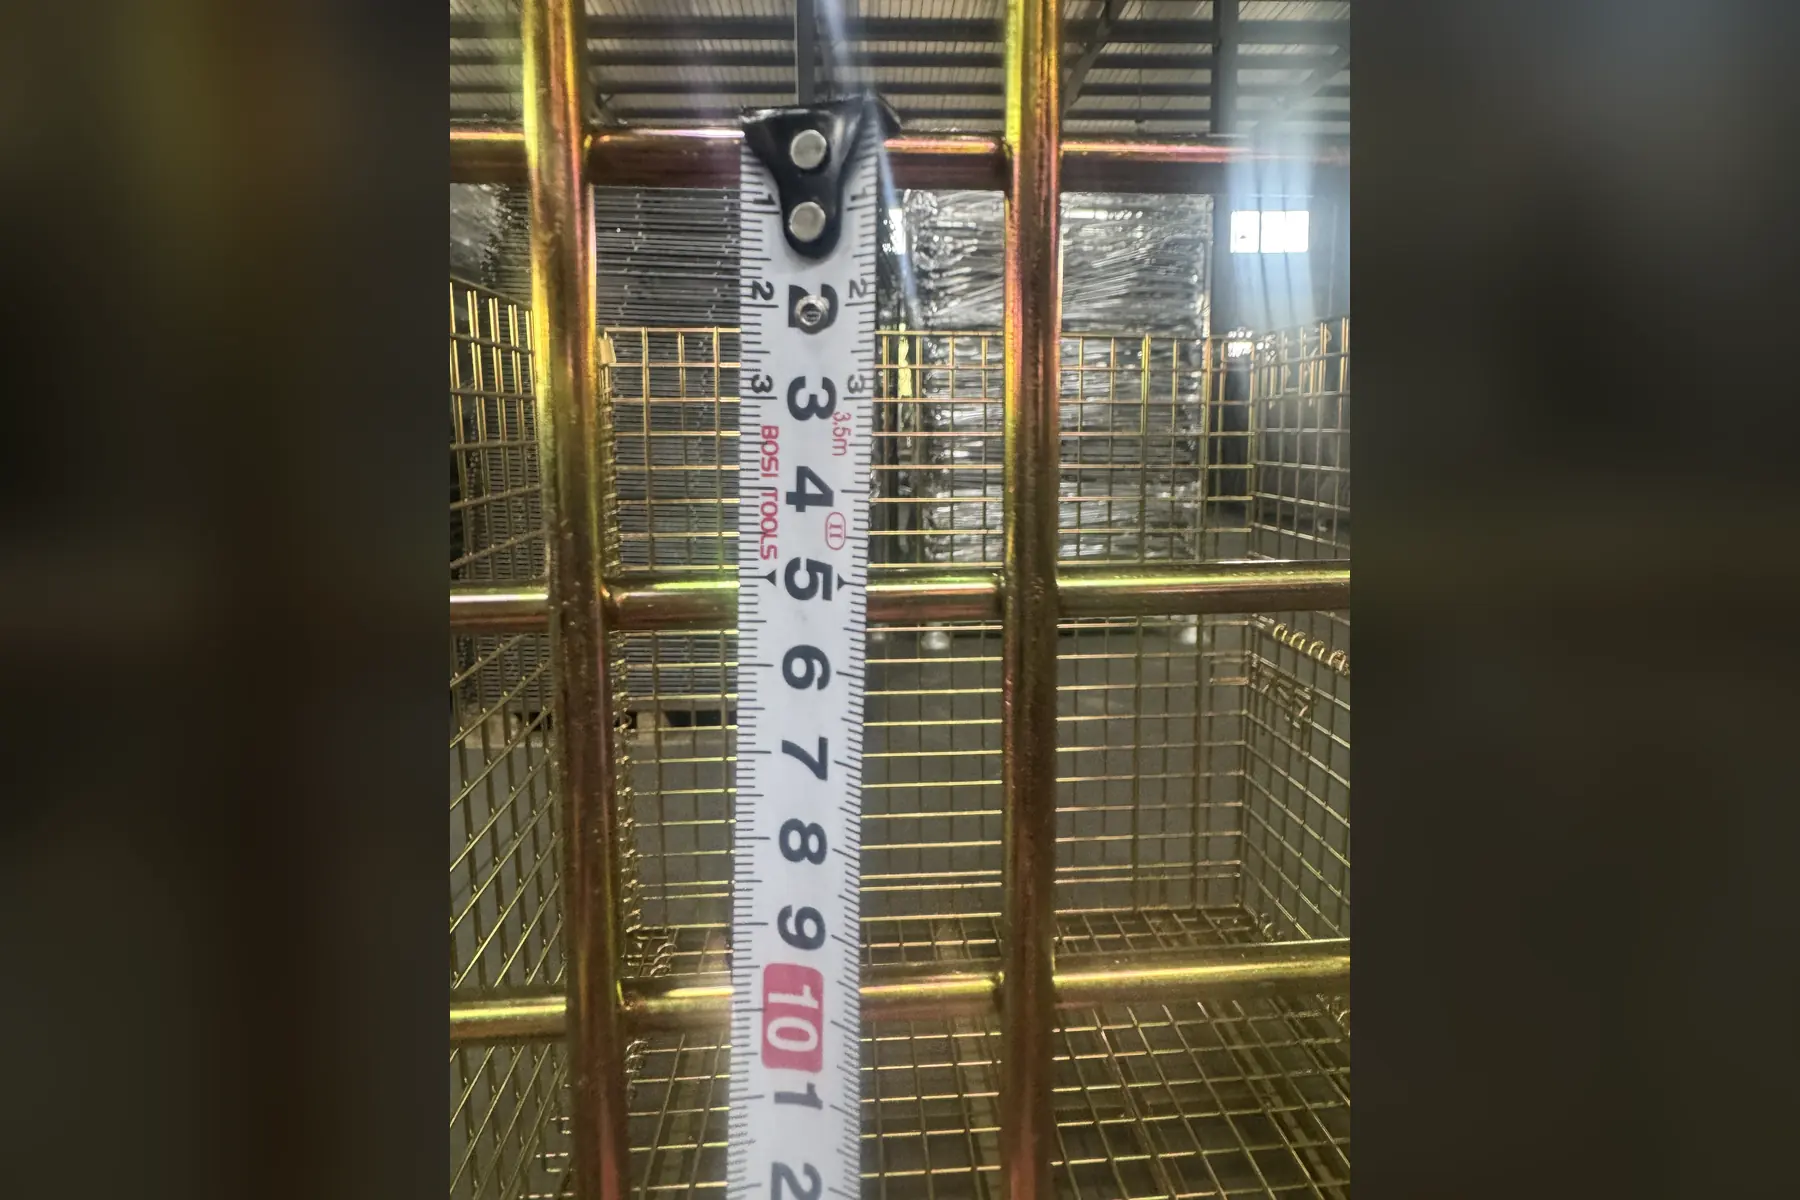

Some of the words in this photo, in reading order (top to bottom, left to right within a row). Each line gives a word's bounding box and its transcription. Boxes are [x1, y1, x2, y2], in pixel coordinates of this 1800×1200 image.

[753, 193, 776, 205] 1
[751, 280, 774, 301] 2
[788, 283, 838, 331] 2
[848, 278, 868, 298] 2
[751, 374, 773, 394] 3
[787, 376, 837, 421] 3
[847, 374, 865, 394] 3
[761, 425, 779, 477] BOSI
[785, 465, 834, 513] 4
[760, 488, 778, 560] TOOLS
[784, 556, 833, 601] 5
[782, 644, 831, 691] 6
[781, 734, 828, 781] 7
[778, 817, 827, 865] 8
[777, 905, 825, 951] 9
[766, 984, 819, 1052] 10
[774, 1080, 823, 1110] 1
[771, 1161, 823, 1200] 2
